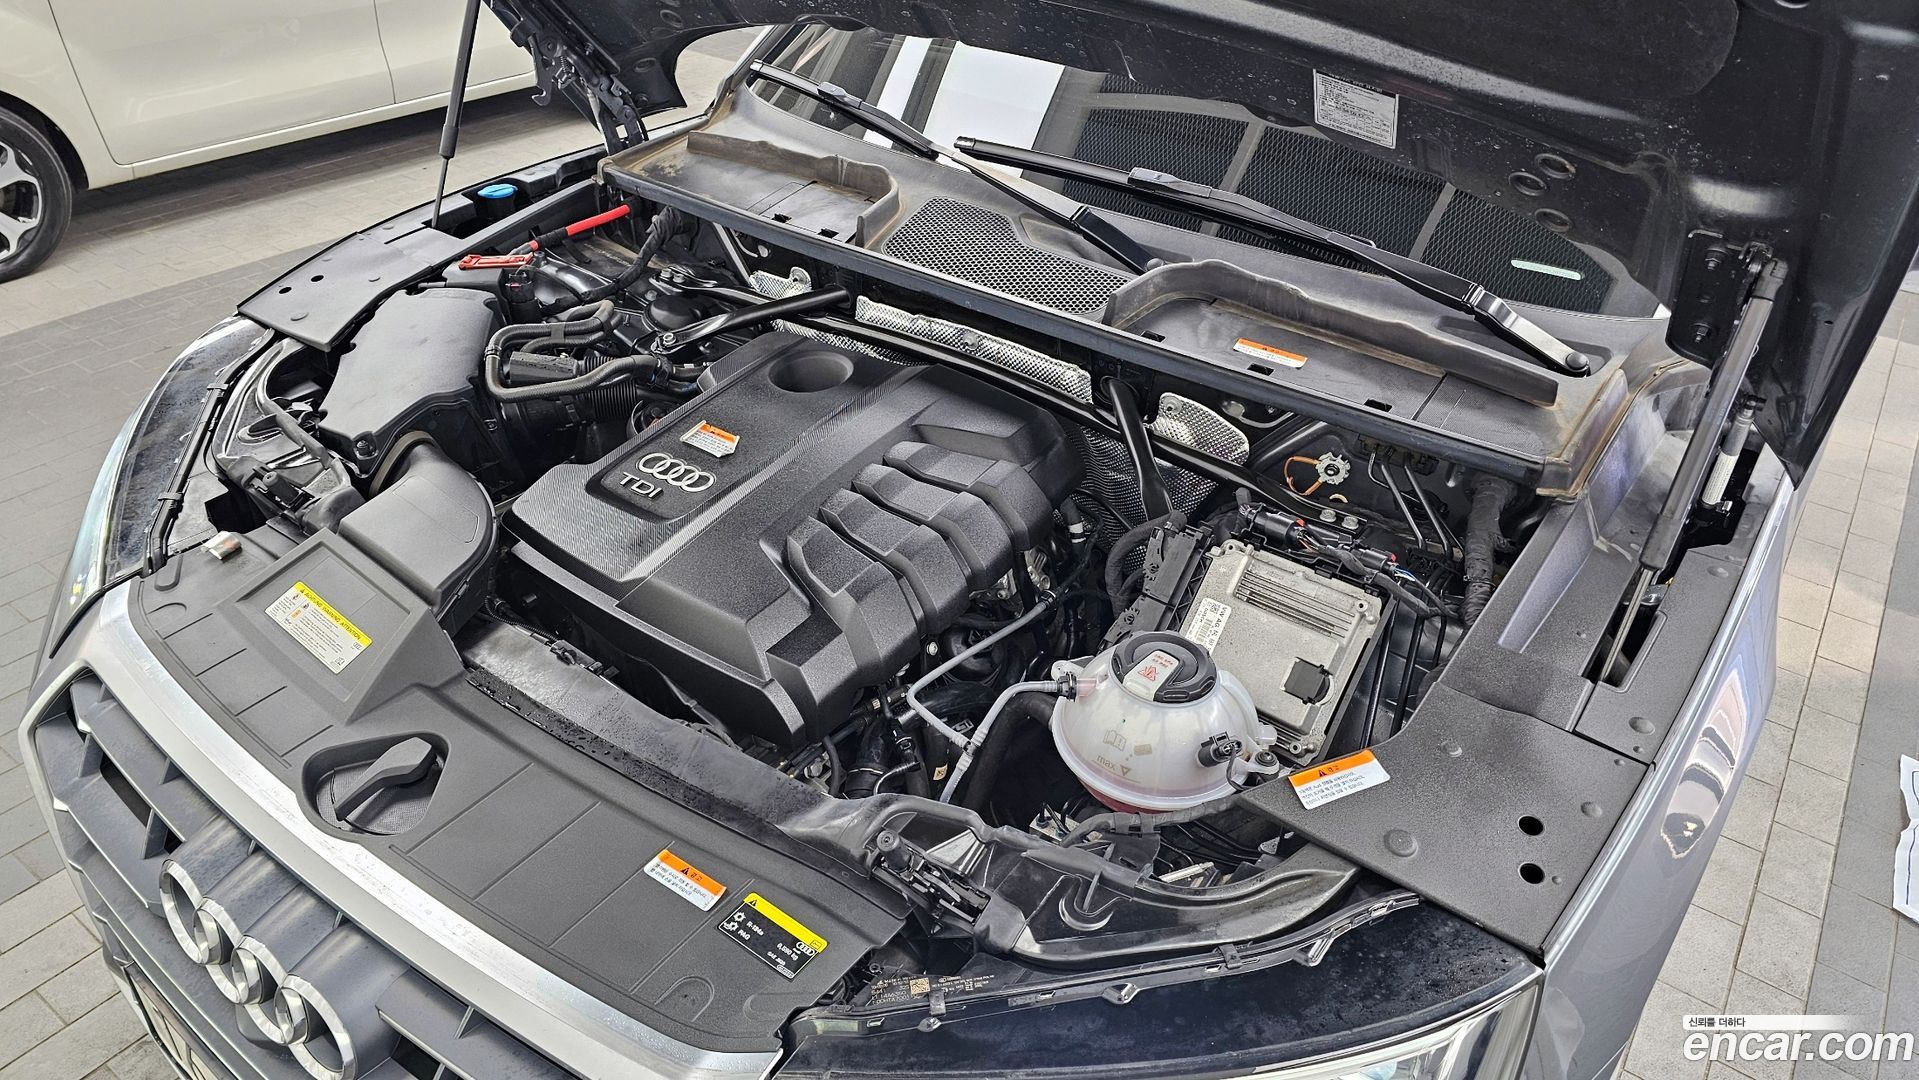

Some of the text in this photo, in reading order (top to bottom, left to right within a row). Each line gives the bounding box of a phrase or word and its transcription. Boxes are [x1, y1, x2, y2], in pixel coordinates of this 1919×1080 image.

[620, 471, 663, 498] TDI
[322, 607, 340, 623] WARNING
[340, 621, 361, 640] ATTENTION
[690, 872, 703, 881] 경고
[738, 929, 751, 940] PAG
[746, 921, 764, 936] R-134a
[791, 952, 799, 961] kg
